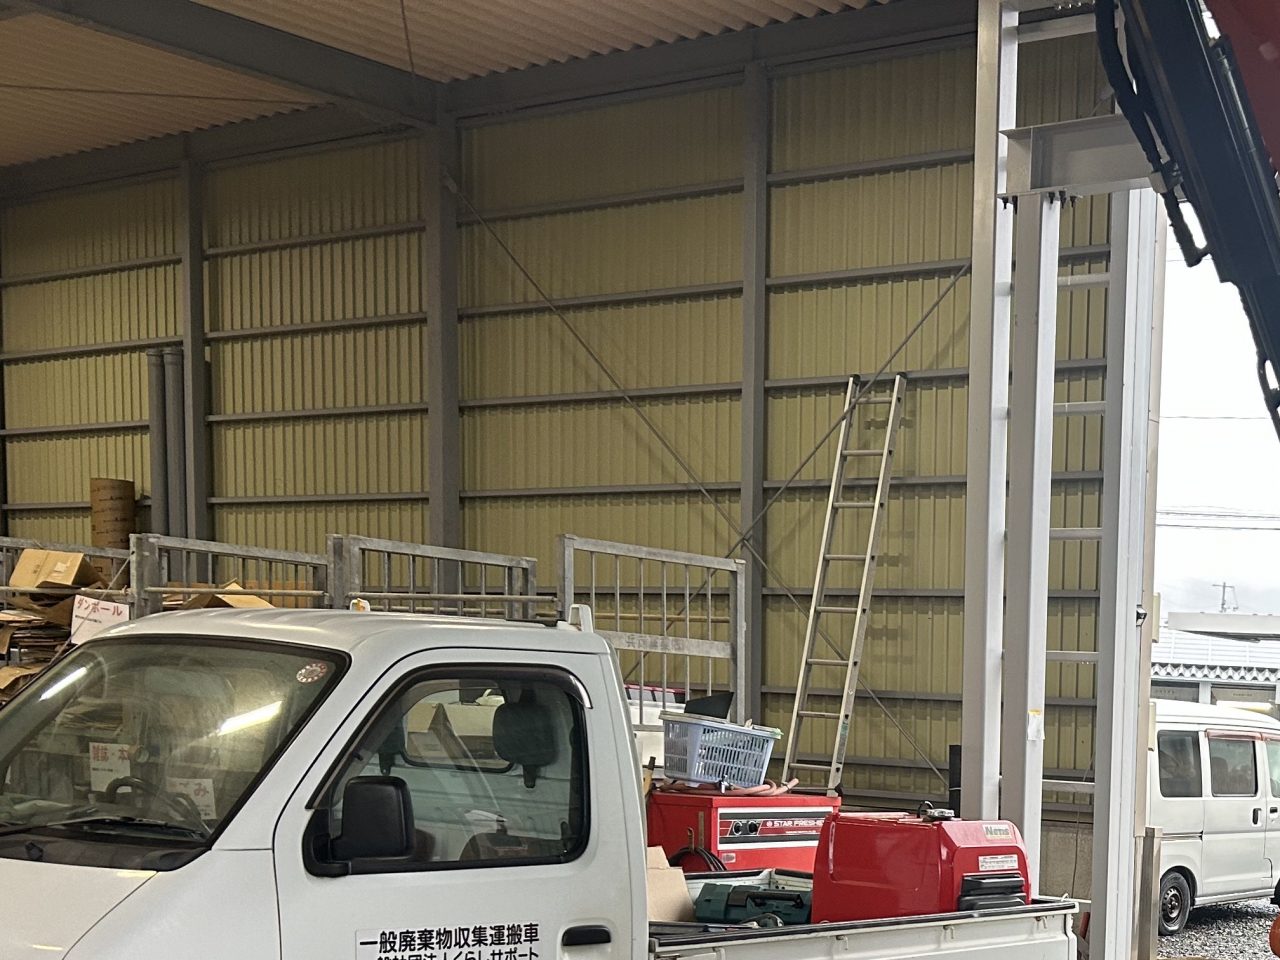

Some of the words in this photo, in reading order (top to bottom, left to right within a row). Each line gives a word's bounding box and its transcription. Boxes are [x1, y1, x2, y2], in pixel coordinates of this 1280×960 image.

[77, 597, 123, 616] ダンボール
[793, 819, 825, 827] FRESHE
[359, 922, 540, 953] 一般廃棄物収集運搬車
